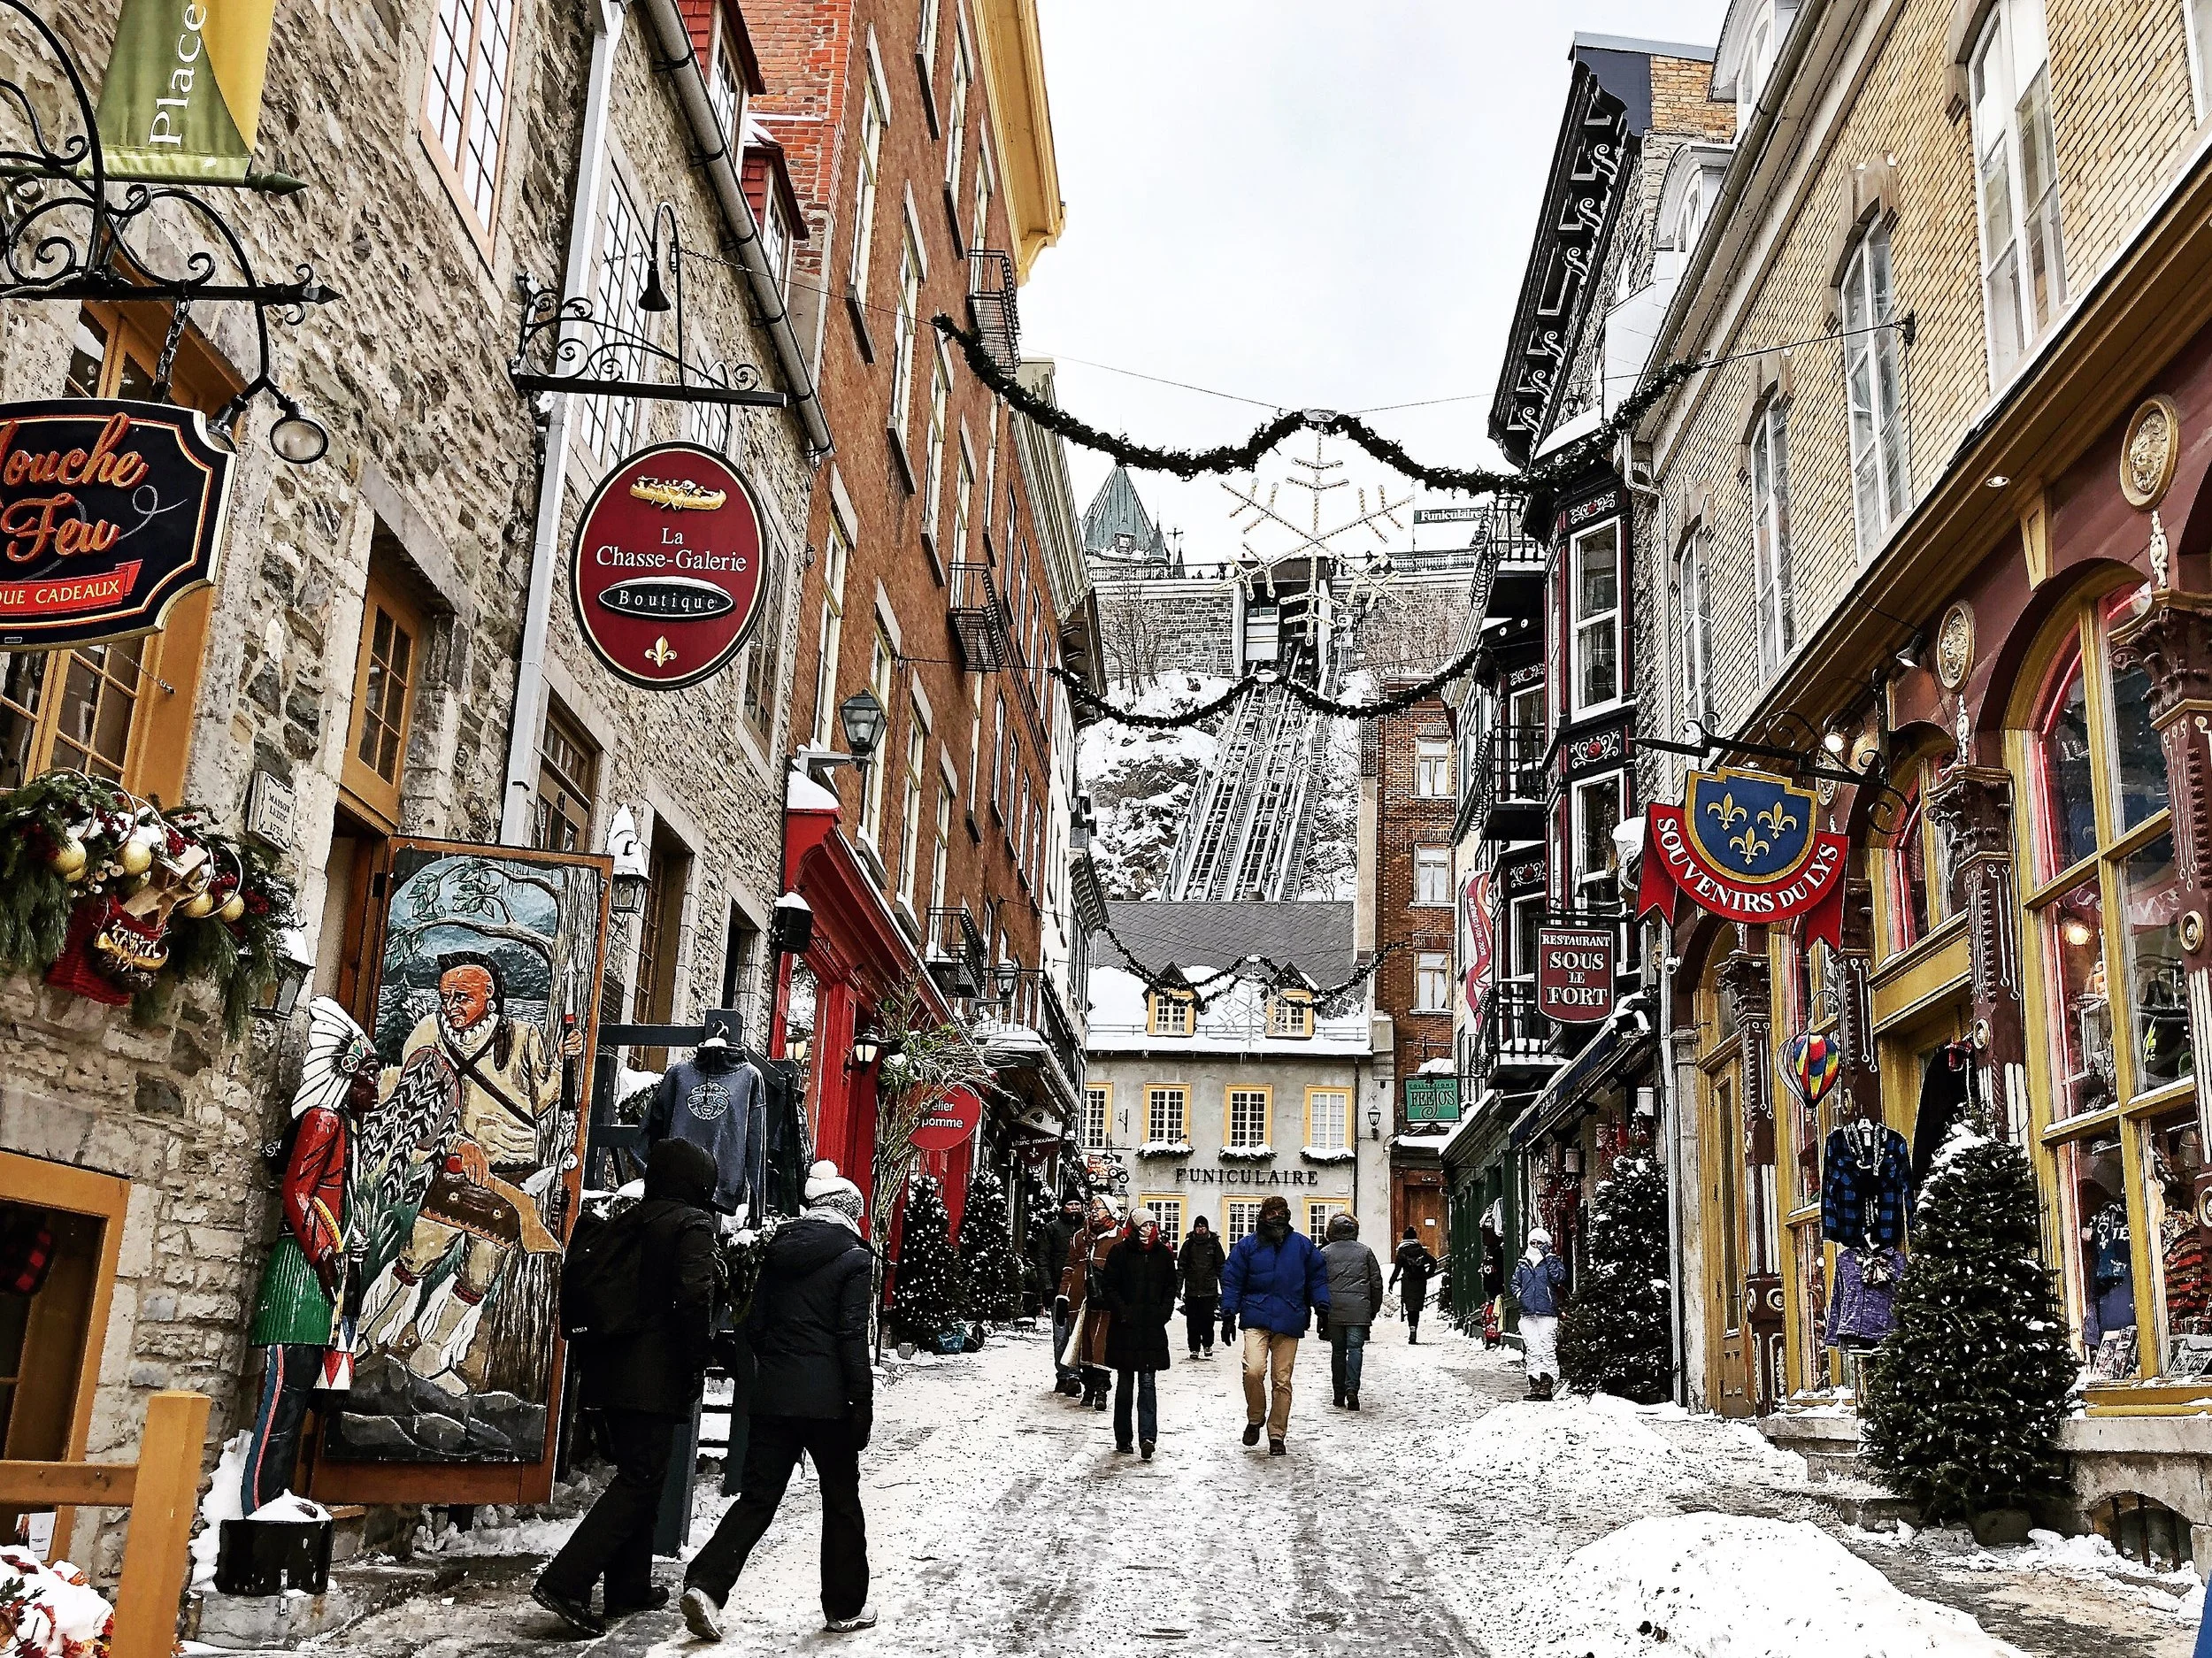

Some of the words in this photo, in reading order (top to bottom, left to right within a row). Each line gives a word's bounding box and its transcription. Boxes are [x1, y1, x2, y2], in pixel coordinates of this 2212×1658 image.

[149, 4, 206, 147] Place
[1420, 509, 1482, 521] Funiculaire
[1, 492, 121, 563] Feu
[661, 527, 684, 545] La
[595, 545, 748, 572] Chasse-Galerie
[0, 590, 26, 605] UE
[35, 580, 119, 604] CADEAUX
[618, 589, 717, 612] Boutique
[269, 793, 290, 813] MAISON
[1656, 817, 1775, 913] SOUVENIRS
[1776, 885, 1809, 909] DU
[1804, 843, 1839, 890] LYS
[1541, 934, 1610, 947] RESTAURANT
[1549, 951, 1604, 971] SOUS
[1568, 971, 1586, 984] LE
[1546, 986, 1608, 1006] FORT
[920, 1101, 955, 1111] aelier
[922, 1117, 964, 1128] pomme
[1176, 1167, 1318, 1186] FUNICULAIRE
